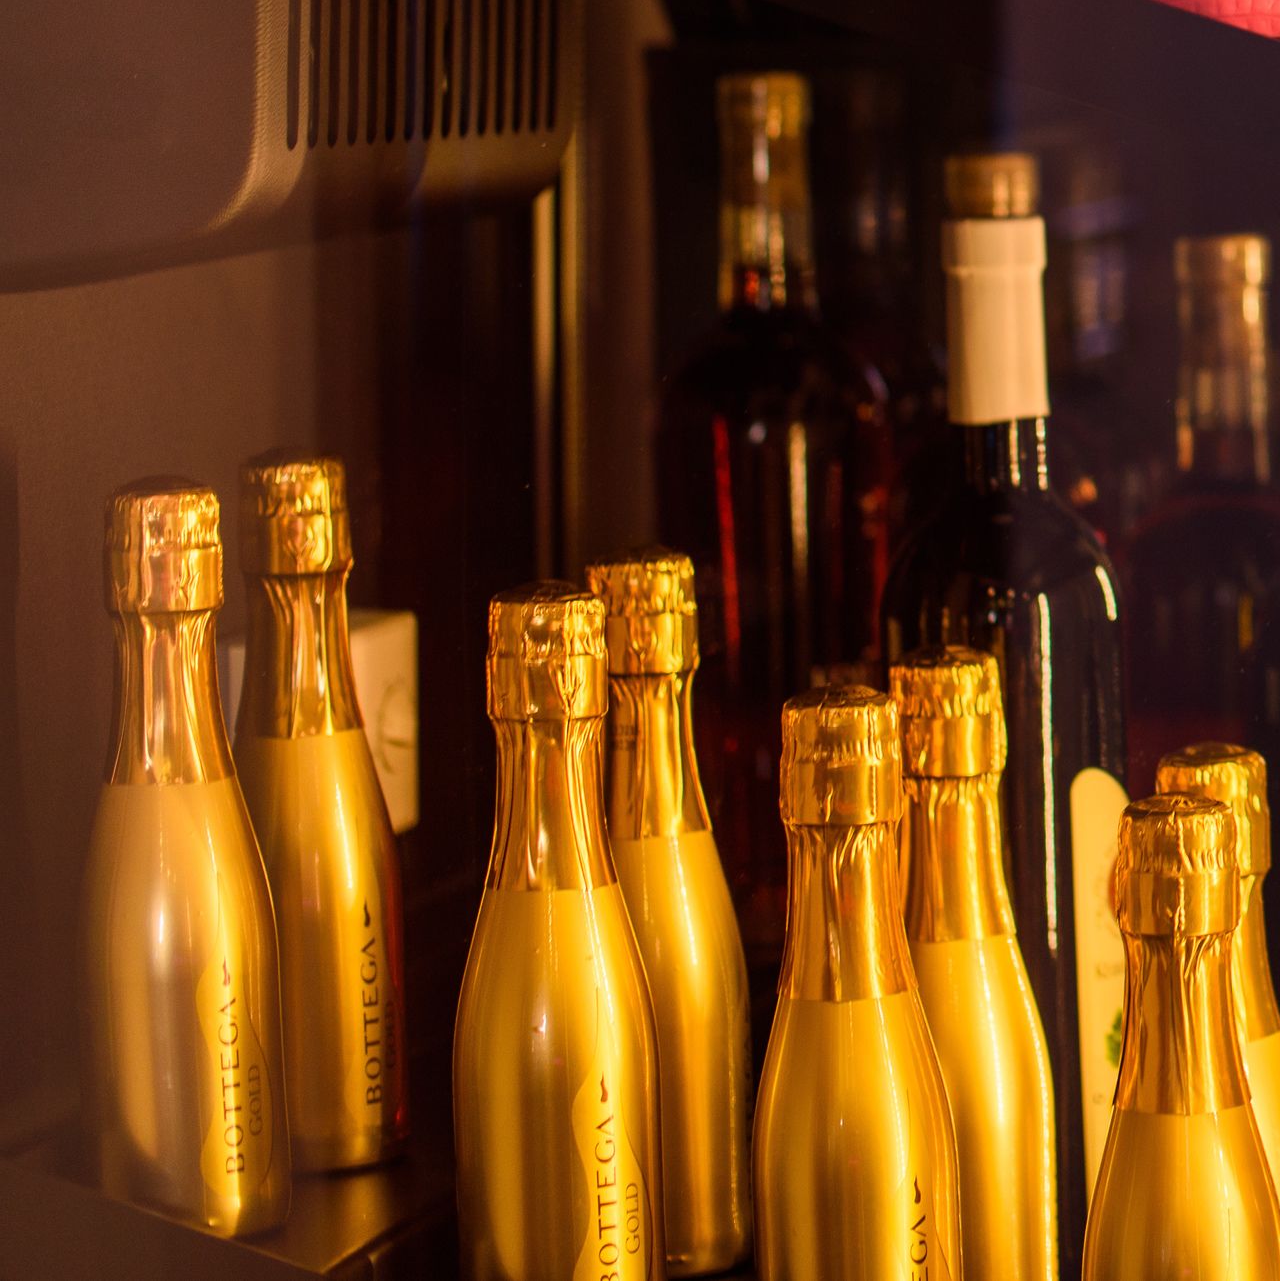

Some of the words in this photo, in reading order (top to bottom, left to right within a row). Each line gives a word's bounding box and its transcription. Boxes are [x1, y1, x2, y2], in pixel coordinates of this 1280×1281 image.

[360, 937, 382, 1106] BOTTEGA
[218, 997, 245, 1175] BOTTEGA
[247, 1064, 263, 1137] GOLD
[625, 1182, 641, 1255] GOLD
